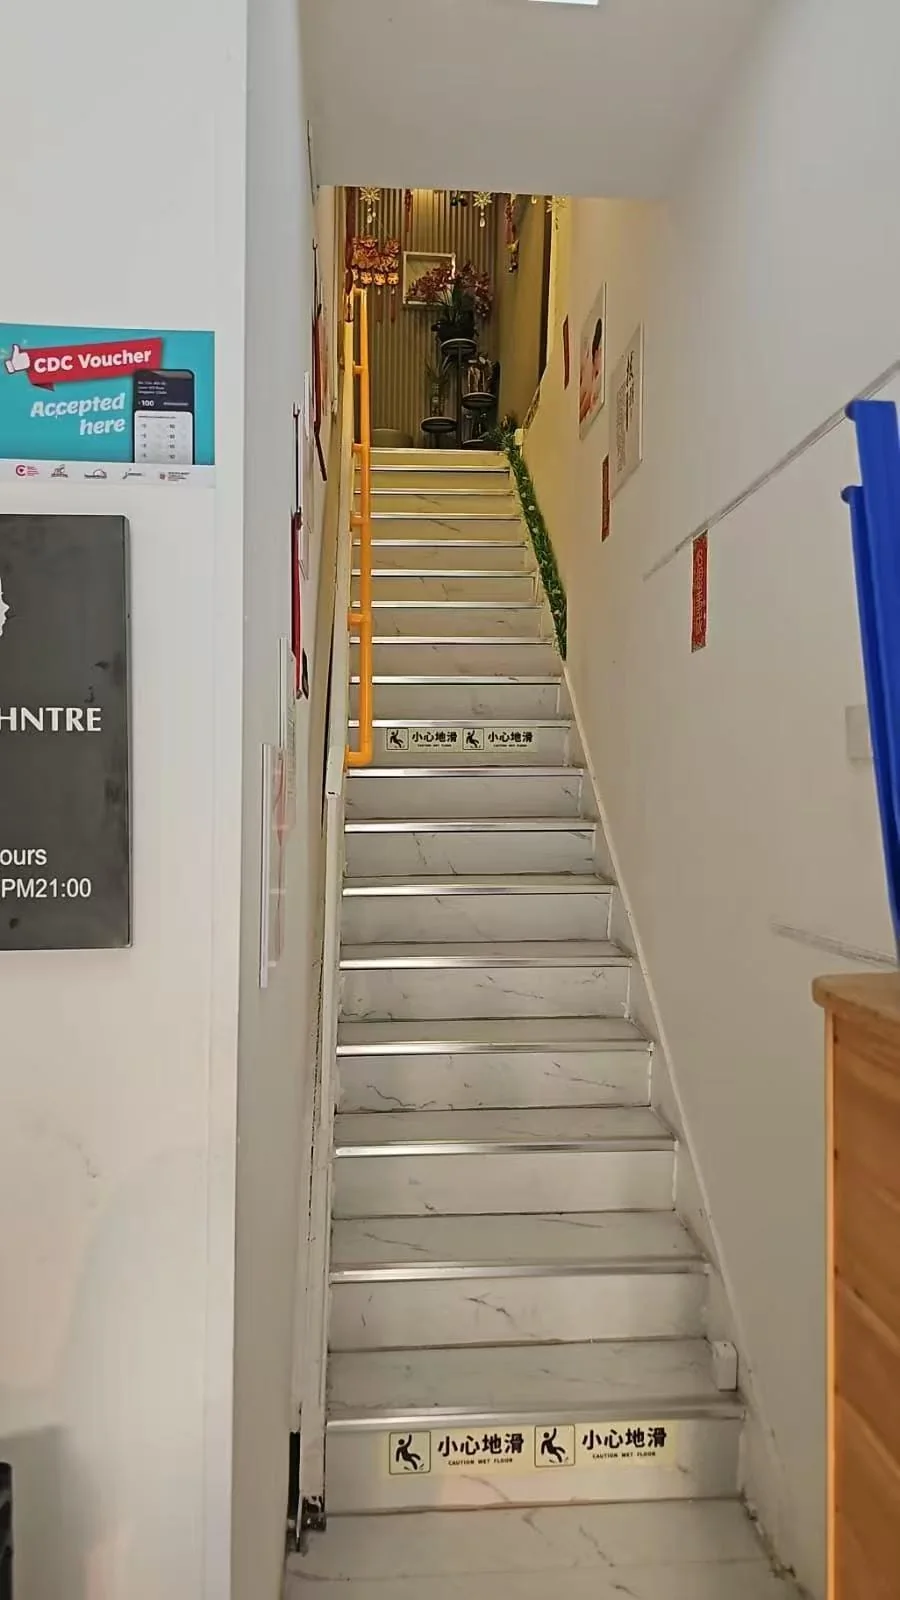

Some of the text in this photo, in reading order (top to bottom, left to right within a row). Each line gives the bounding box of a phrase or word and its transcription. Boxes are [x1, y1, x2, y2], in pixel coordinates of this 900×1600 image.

[33, 349, 151, 373] CDC Voucher
[30, 392, 125, 419] Accepted
[79, 418, 125, 436] here
[412, 731, 458, 743] 小心地滑
[487, 731, 533, 743] 小心地滑
[0, 848, 48, 866] ours
[1, 878, 92, 898] PM21:00
[438, 1432, 525, 1457] 小心地滑
[582, 1426, 667, 1451] 小心地滑
